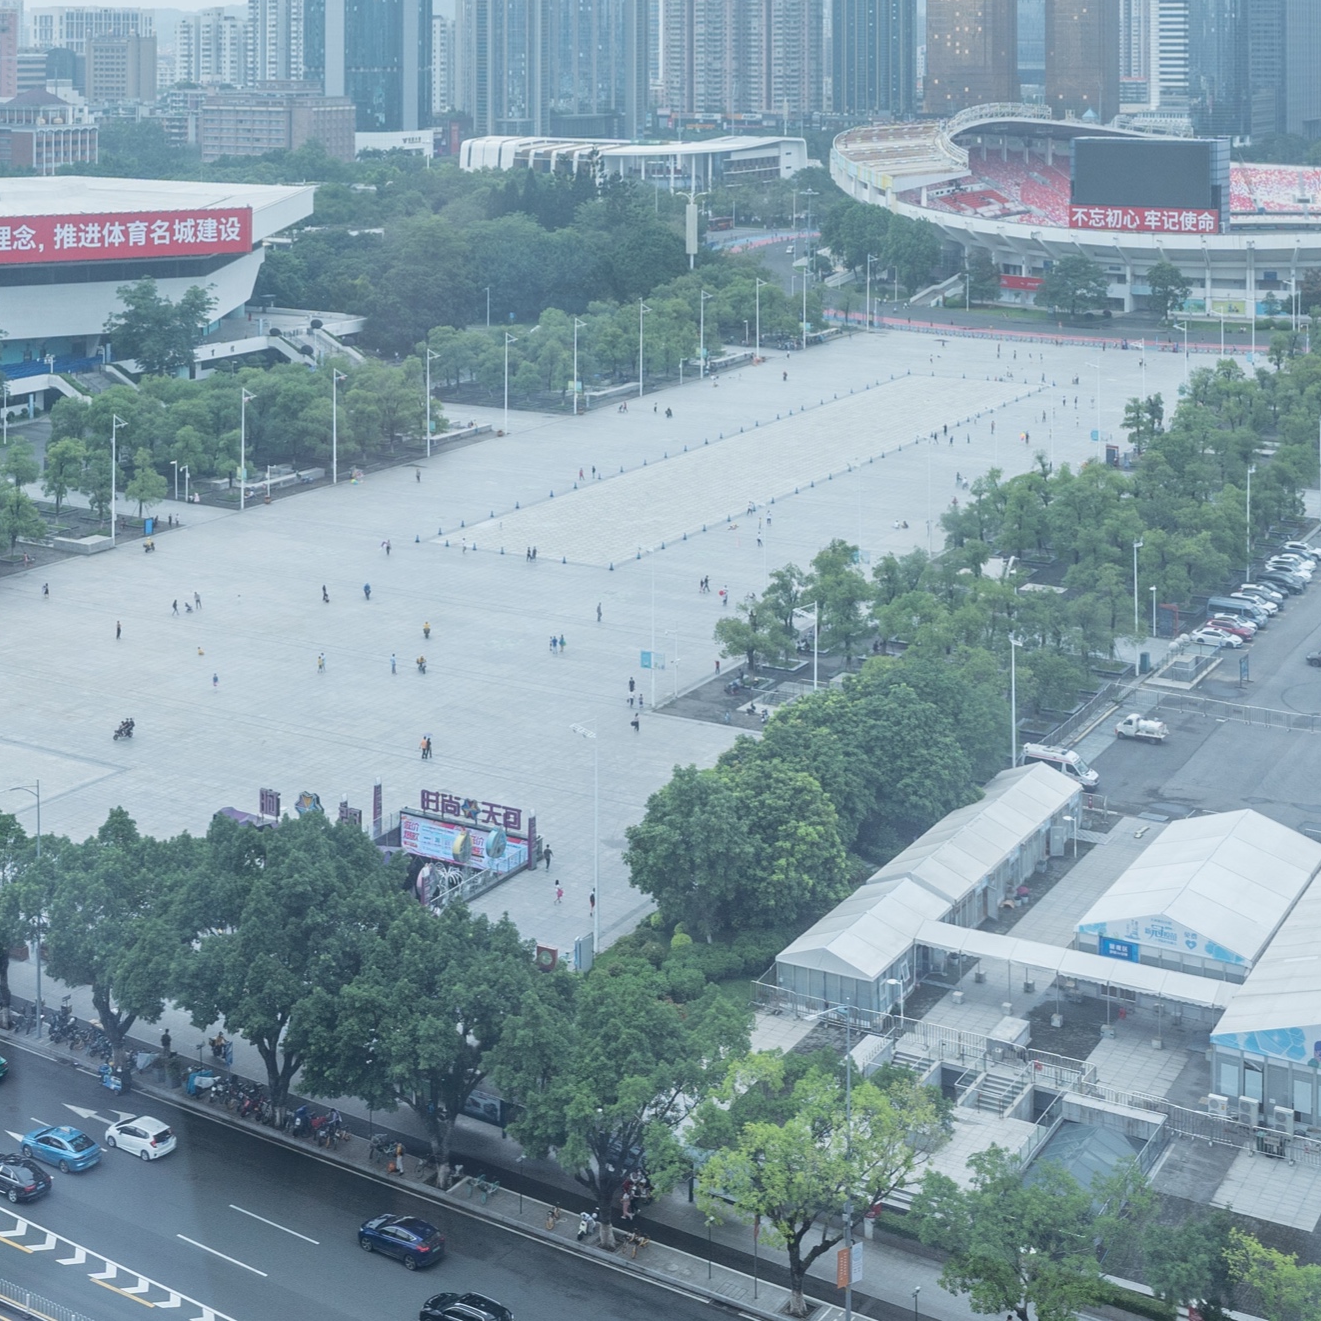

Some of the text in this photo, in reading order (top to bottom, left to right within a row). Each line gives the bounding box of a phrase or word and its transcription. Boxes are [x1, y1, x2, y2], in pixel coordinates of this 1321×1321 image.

[1071, 207, 1215, 232] 不忘初心 牢记使命
[421, 789, 461, 817] 时尚
